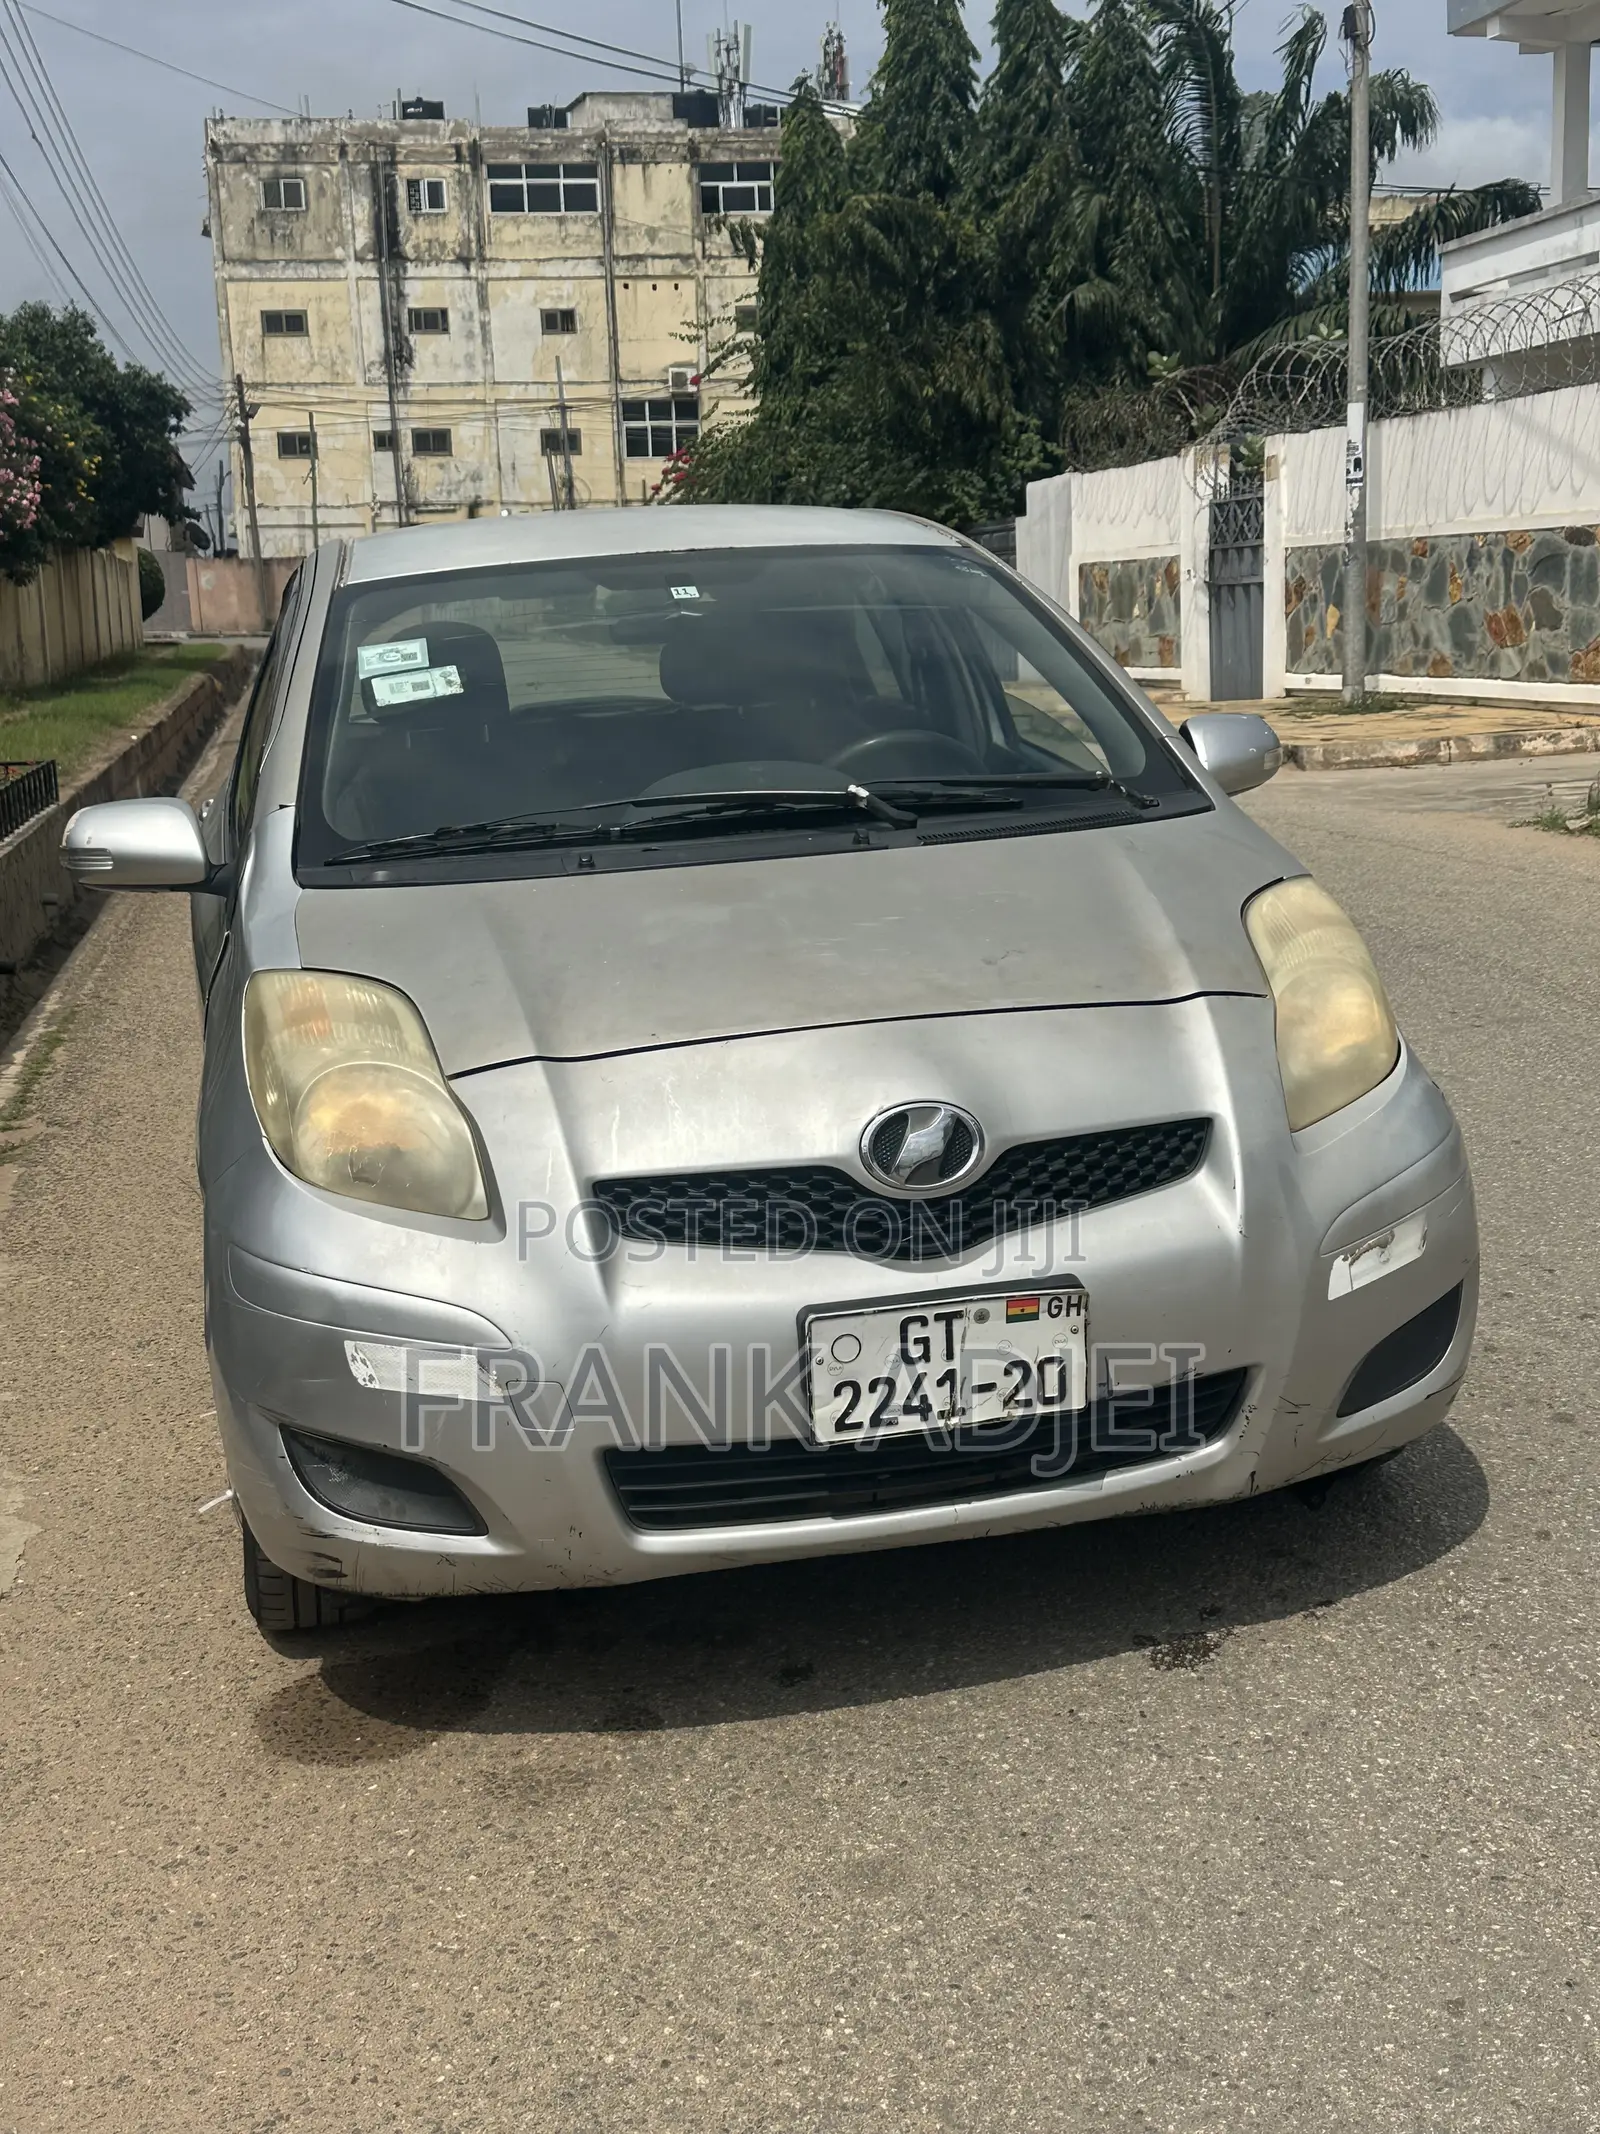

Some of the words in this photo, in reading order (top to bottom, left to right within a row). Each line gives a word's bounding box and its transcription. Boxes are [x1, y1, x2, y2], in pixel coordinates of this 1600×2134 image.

[1046, 1295, 1083, 1319] GH
[899, 1310, 964, 1365] GT
[833, 1355, 1067, 1433] 2241-20
